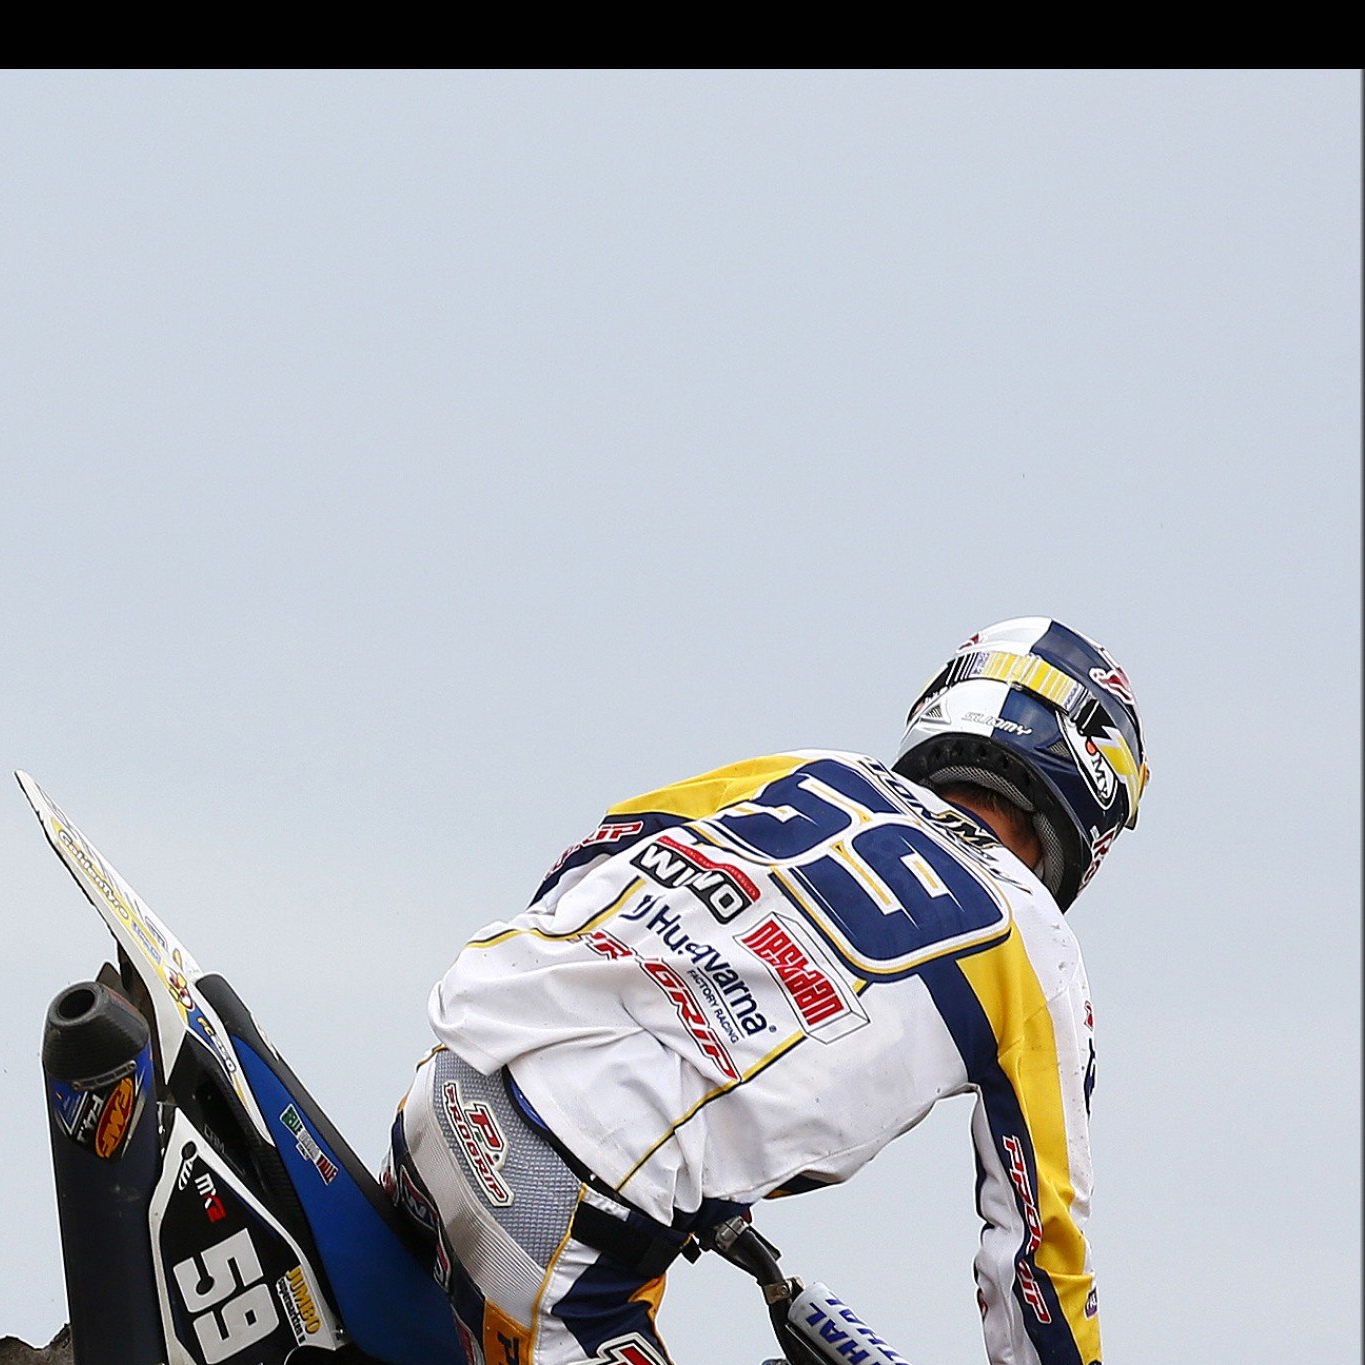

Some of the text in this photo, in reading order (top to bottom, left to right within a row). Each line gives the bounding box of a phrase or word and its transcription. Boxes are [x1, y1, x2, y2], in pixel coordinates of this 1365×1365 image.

[962, 711, 1033, 736] SUOMY
[705, 757, 1011, 967] 59
[687, 969, 741, 1045] FACTORY RACING
[444, 1084, 507, 1200] PROGRIP
[172, 1227, 280, 1365] 59
[285, 1264, 322, 1335] JUMBO
